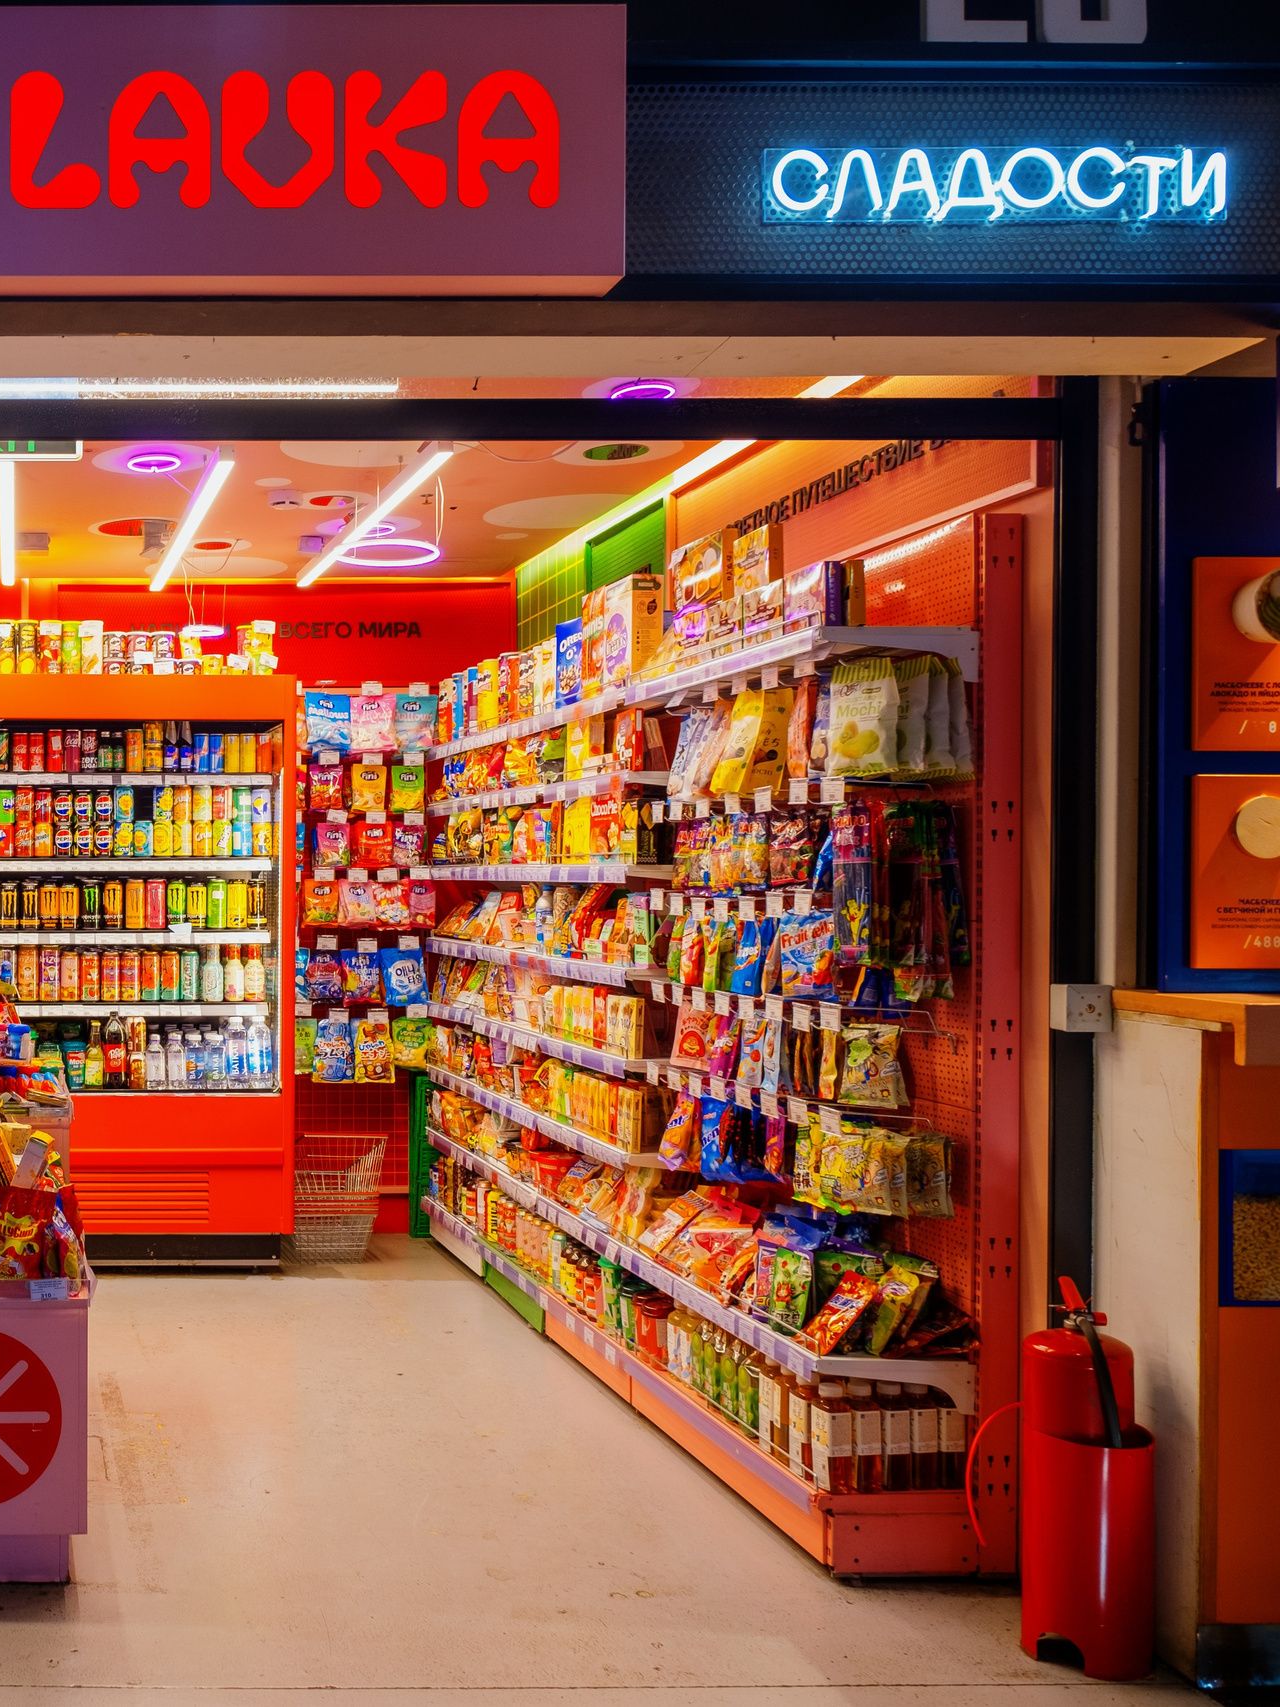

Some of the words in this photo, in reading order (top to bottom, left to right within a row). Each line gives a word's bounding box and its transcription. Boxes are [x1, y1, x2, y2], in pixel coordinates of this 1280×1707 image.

[10, 71, 560, 209] LAVKA
[772, 147, 1228, 221] СЛАДОСТИ
[792, 440, 925, 516] ПУТЕШЕСТВИЕ
[280, 622, 353, 639] ВСЕГО
[358, 622, 421, 639] МИРА
[559, 632, 583, 653] OREO
[1258, 689, 1280, 698] ЯЙЦО
[318, 700, 335, 709] Fini
[361, 702, 379, 711] Fini
[403, 702, 420, 711] Fini
[836, 701, 882, 719] Mochi
[360, 771, 379, 780] Fini
[400, 772, 417, 781] Fini
[325, 830, 344, 839] Fini
[313, 886, 331, 895] Fini
[349, 886, 366, 895] Fini
[375, 886, 402, 900] Trolli
[1223, 905, 1265, 914] ВЕТЧИНОЙ
[39, 956, 61, 964] AriZo
[231, 1042, 240, 1076] BAIKAL
[212, 1053, 220, 1080] BAIKAL
